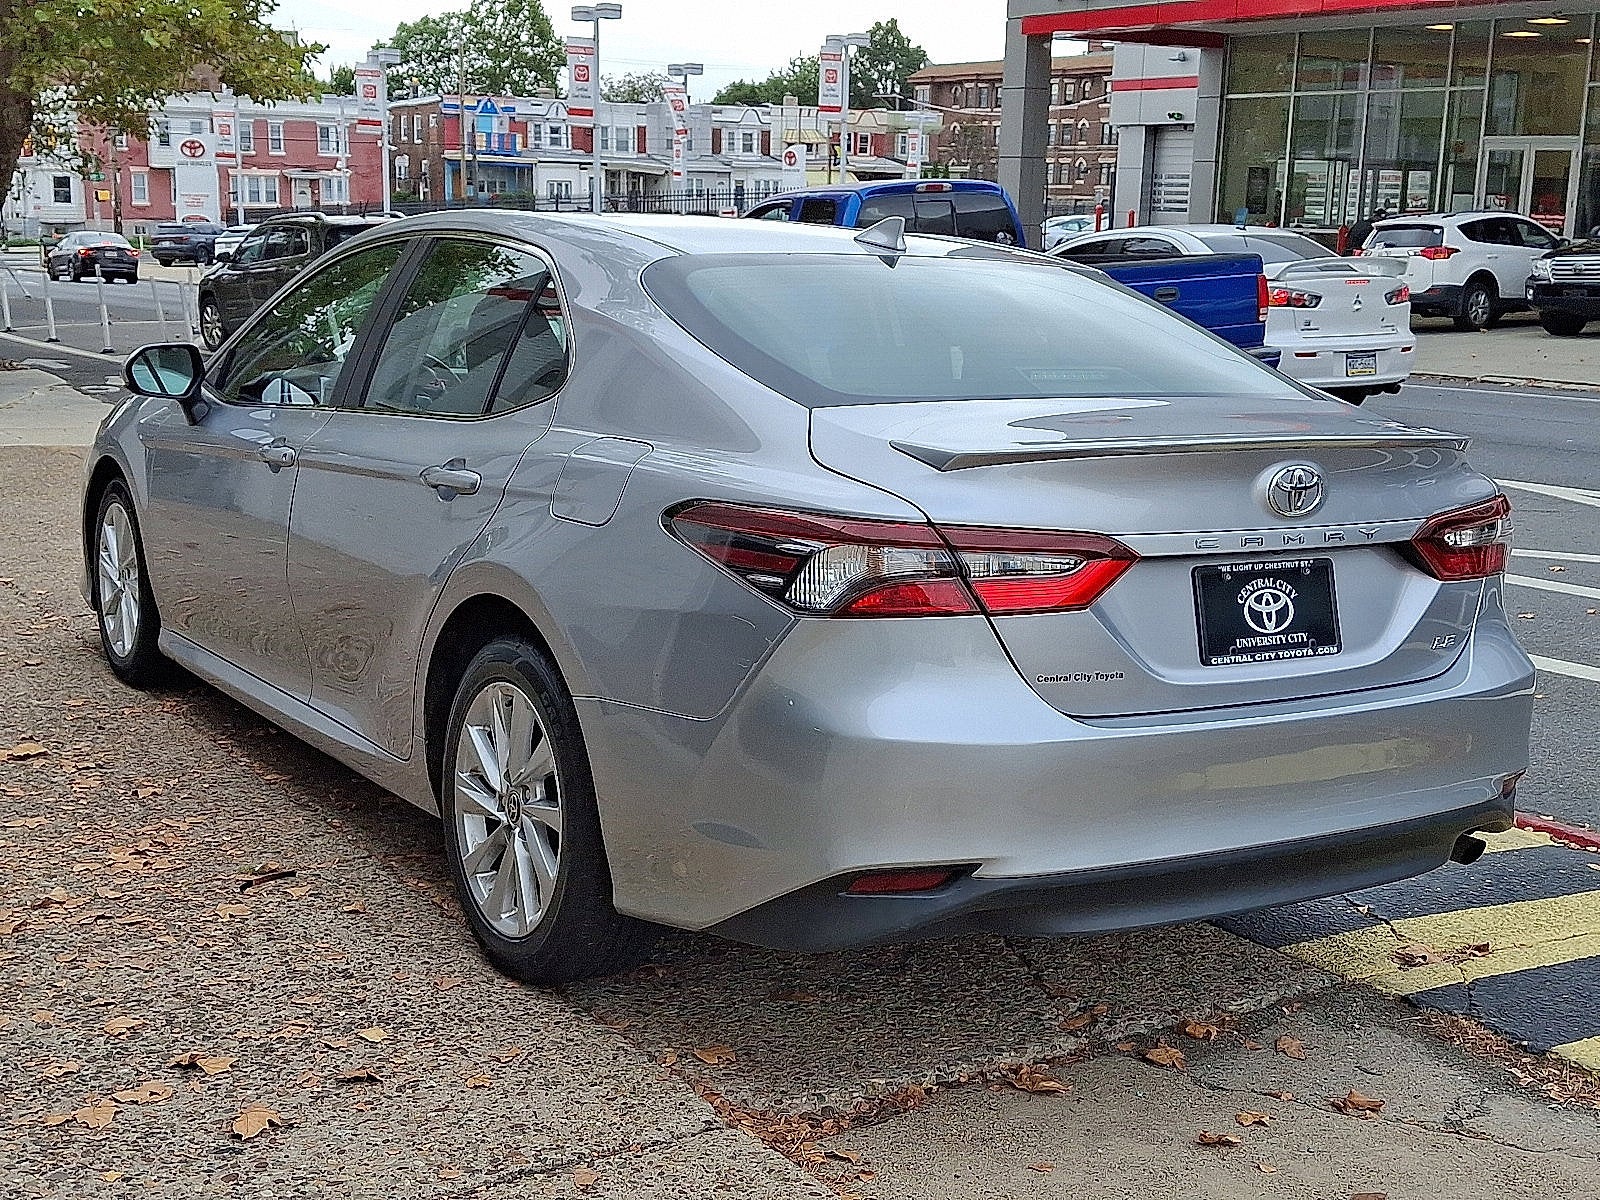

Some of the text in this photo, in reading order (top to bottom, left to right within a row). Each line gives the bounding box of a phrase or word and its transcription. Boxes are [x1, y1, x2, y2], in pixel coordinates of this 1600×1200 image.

[1195, 527, 1381, 549] CAMRY
[1233, 563, 1252, 572] LIGHT
[1265, 561, 1299, 570] CHESTNUT
[1237, 577, 1299, 604] CENTRAL CITY
[1236, 632, 1308, 648] UNIVERSITY CITY
[1211, 646, 1338, 664] CENTRAL CITY TOYOTA .COM
[1036, 671, 1124, 683] Central City Toyota
